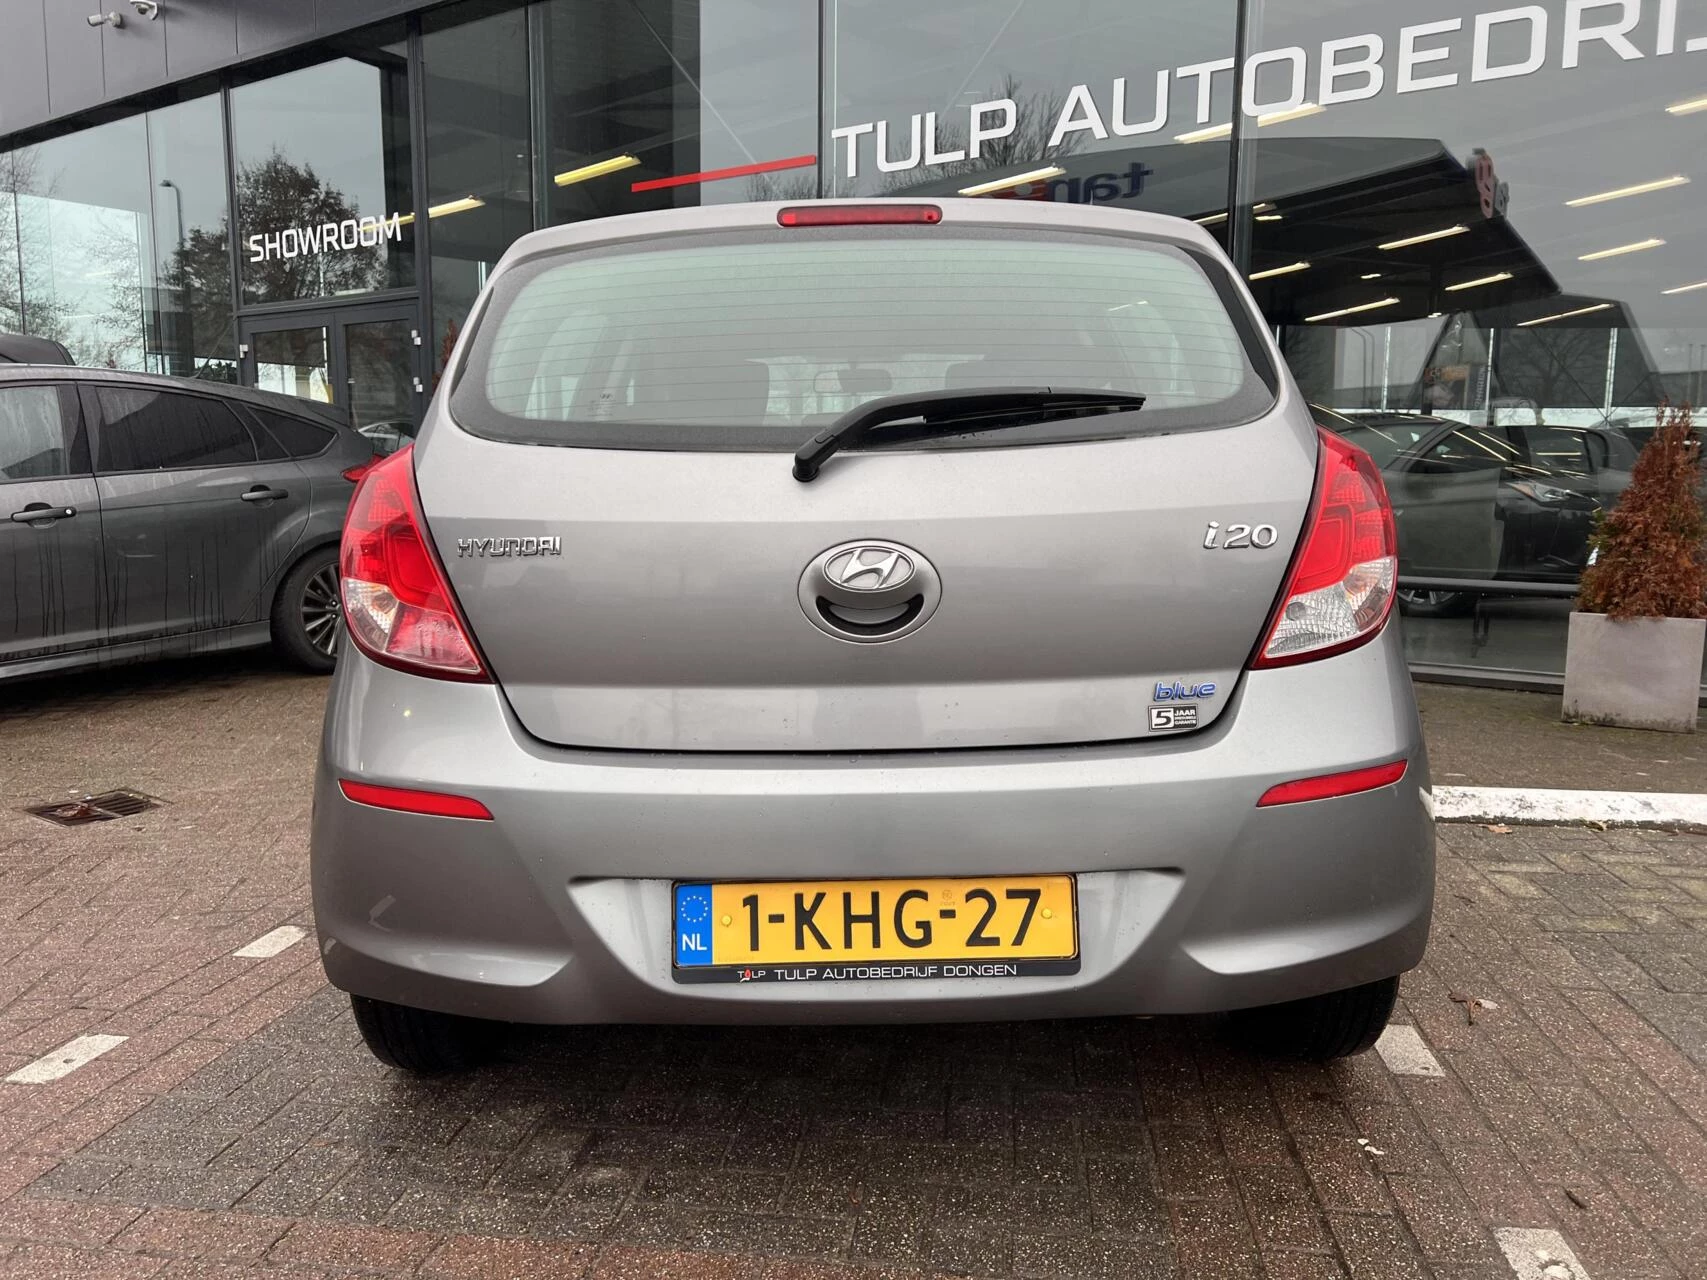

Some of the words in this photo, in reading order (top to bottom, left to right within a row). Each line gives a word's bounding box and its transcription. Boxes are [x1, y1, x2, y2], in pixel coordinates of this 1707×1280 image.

[831, 98, 1017, 178] TULP
[1047, 0, 1707, 146] AUTOBEDRI
[249, 211, 402, 263] SHOWROOM
[1203, 520, 1278, 549] i20
[457, 536, 562, 557] HYUNDAI
[1154, 681, 1216, 702] blue
[1153, 709, 1172, 727] 5
[742, 887, 1042, 952] 1-KHG-27
[681, 932, 708, 951] NL
[774, 968, 818, 980] TULP
[822, 965, 938, 980] AUTOBEDRIJF
[943, 964, 1017, 977] DONGEN
